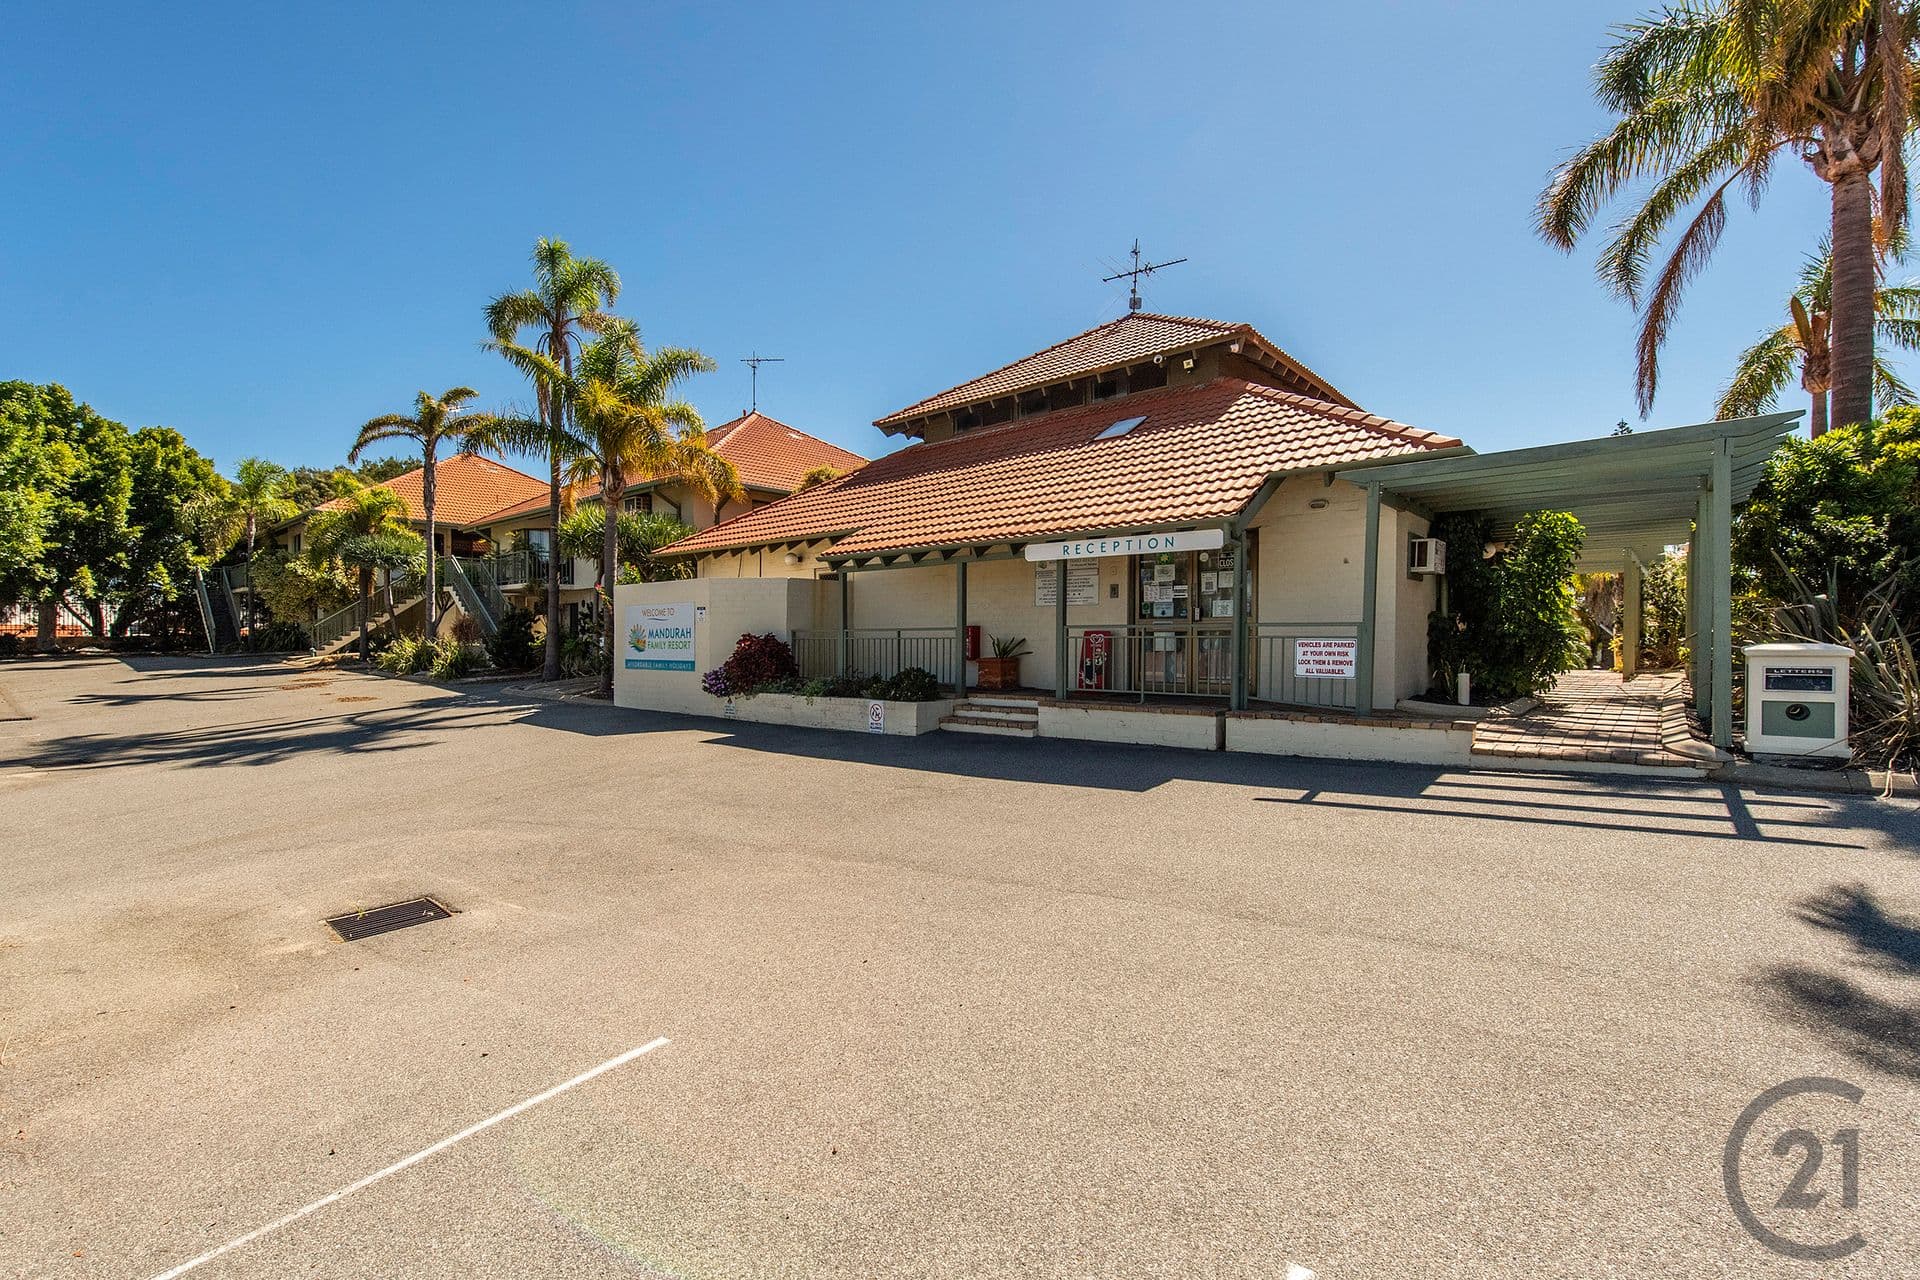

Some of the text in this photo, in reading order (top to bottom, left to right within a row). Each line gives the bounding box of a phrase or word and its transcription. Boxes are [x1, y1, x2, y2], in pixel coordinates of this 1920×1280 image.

[1062, 536, 1176, 556] RECEPTION
[641, 607, 675, 617] WELCOME TO
[648, 627, 692, 639] MANDURAH
[647, 640, 691, 650] FAMILY RESORT
